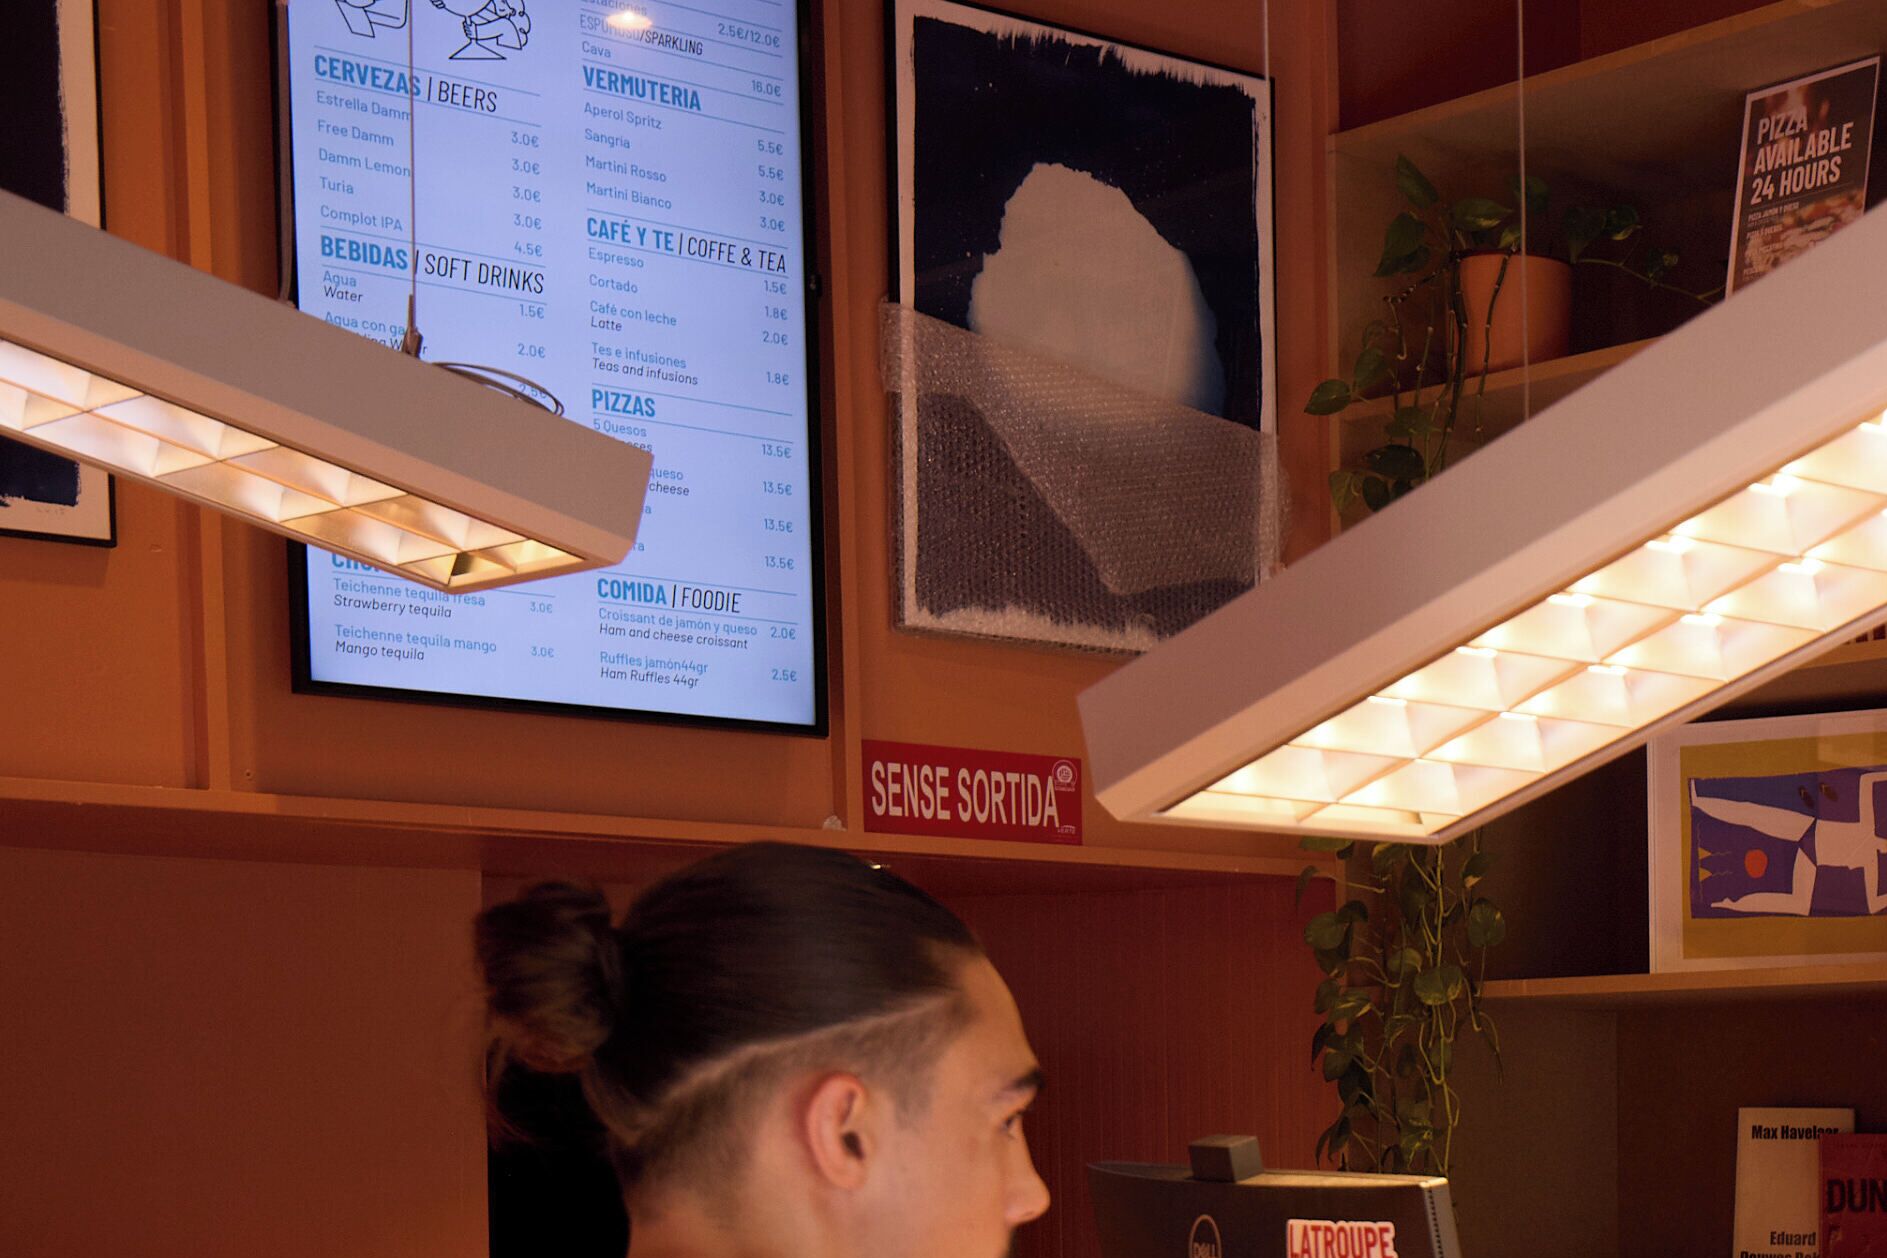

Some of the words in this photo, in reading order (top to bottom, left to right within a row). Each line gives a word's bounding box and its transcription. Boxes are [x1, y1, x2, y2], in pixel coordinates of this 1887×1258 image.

[582, 40, 611, 58] Cava
[718, 23, 780, 48] 2.5€/12.0€
[314, 55, 421, 96] CERVEZAS
[438, 80, 498, 112] BEERS
[583, 65, 701, 111] VERMUTERIA
[752, 80, 781, 97] 16.0€
[316, 90, 368, 112] Estrella
[584, 102, 624, 122] Aperol
[626, 112, 662, 130] Spritz
[1758, 106, 1808, 144] PIZZA
[318, 120, 348, 136] Free
[352, 126, 394, 146] Damm
[512, 131, 540, 148] 3.0€
[584, 129, 630, 150] Sangria
[758, 140, 783, 156] 5.5€
[1754, 122, 1854, 174] AVAILABLE
[319, 148, 361, 168] Damm
[366, 158, 411, 177] Lemon
[512, 159, 540, 175] 3.0€
[586, 156, 627, 174] Martini
[630, 165, 667, 182] Rosso
[758, 166, 784, 181] 5.5€
[320, 176, 354, 194] Turia
[513, 186, 541, 202] 3.0€
[1750, 175, 1774, 206] 24
[1780, 156, 1842, 197] HOURS
[587, 182, 628, 200] Martini
[632, 190, 672, 210] Bianco
[759, 191, 784, 206] 3.0€
[320, 206, 376, 227] Complot
[382, 217, 403, 232] IPA
[514, 214, 542, 230] 3.0€
[760, 216, 785, 232] 3.0€
[514, 242, 542, 258] 4.5€
[587, 218, 631, 244] CAFÉ
[636, 227, 646, 246] Y
[653, 230, 674, 251] TE
[688, 236, 736, 264] COFFE
[740, 248, 752, 266] &
[758, 250, 786, 273] TEA
[589, 248, 644, 268] Espresso
[321, 235, 408, 270] BEBIDAS
[424, 254, 472, 280] SOFT
[478, 263, 544, 294] DRINKS
[322, 270, 356, 289] Agua
[764, 280, 786, 295] 1.5€
[324, 285, 364, 302] Water
[520, 304, 544, 319] 1.5€
[590, 274, 638, 294] Cortado
[765, 306, 788, 321] 1.8€
[590, 300, 616, 316] Café
[620, 308, 642, 320] con
[646, 308, 676, 326] leche
[325, 312, 358, 331] Agua
[362, 320, 386, 332] con
[390, 324, 405, 338] ga
[518, 344, 546, 358] 2.0€
[591, 316, 622, 332] Latte
[763, 331, 788, 346] 2.0€
[592, 342, 612, 356] Tes
[615, 348, 622, 358] e
[626, 349, 686, 369] infusiones
[593, 358, 619, 372] Teas
[622, 363, 644, 377] and
[646, 367, 698, 386] infusions
[766, 371, 790, 386] 1.8€
[592, 389, 655, 418] PIZZAS
[594, 418, 600, 430] 5
[603, 420, 647, 438] Quesos
[762, 444, 792, 459] 13.5€
[649, 481, 690, 496] cheese
[763, 482, 792, 496] 13.5€
[764, 518, 793, 533] 13.5€
[765, 556, 794, 570] 13.5€
[334, 578, 401, 597] Teichenne
[406, 588, 450, 603] tequila
[598, 578, 667, 605] COMIDA
[682, 587, 741, 614] FOODIE
[334, 594, 405, 615] Strawberry
[409, 604, 452, 618] tequila
[530, 602, 552, 614] 3.0€
[599, 608, 655, 626] Croissant
[659, 614, 672, 626] de
[676, 618, 710, 632] jamón
[714, 622, 720, 634] y
[724, 624, 758, 636] queso
[770, 626, 796, 640] 2.0€
[600, 623, 626, 636] Ham
[629, 627, 650, 640] and
[653, 629, 693, 644] cheese
[696, 634, 748, 650] croissant
[334, 624, 403, 643] Teichenne
[406, 633, 450, 648] tequila
[454, 639, 496, 653] mango
[336, 640, 377, 656] Mango
[382, 647, 424, 660] tequila
[532, 646, 554, 658] 3.0€
[600, 651, 642, 668] Ruffles
[601, 670, 627, 681] Ham
[630, 672, 670, 685] Ruffles
[673, 676, 698, 688] 44gr
[772, 669, 797, 682] 2.5€
[872, 760, 950, 820] SENSE
[958, 768, 1060, 827] SORTIDA
[1752, 1125, 1777, 1139] Max
[1770, 1231, 1816, 1245] Eduard
